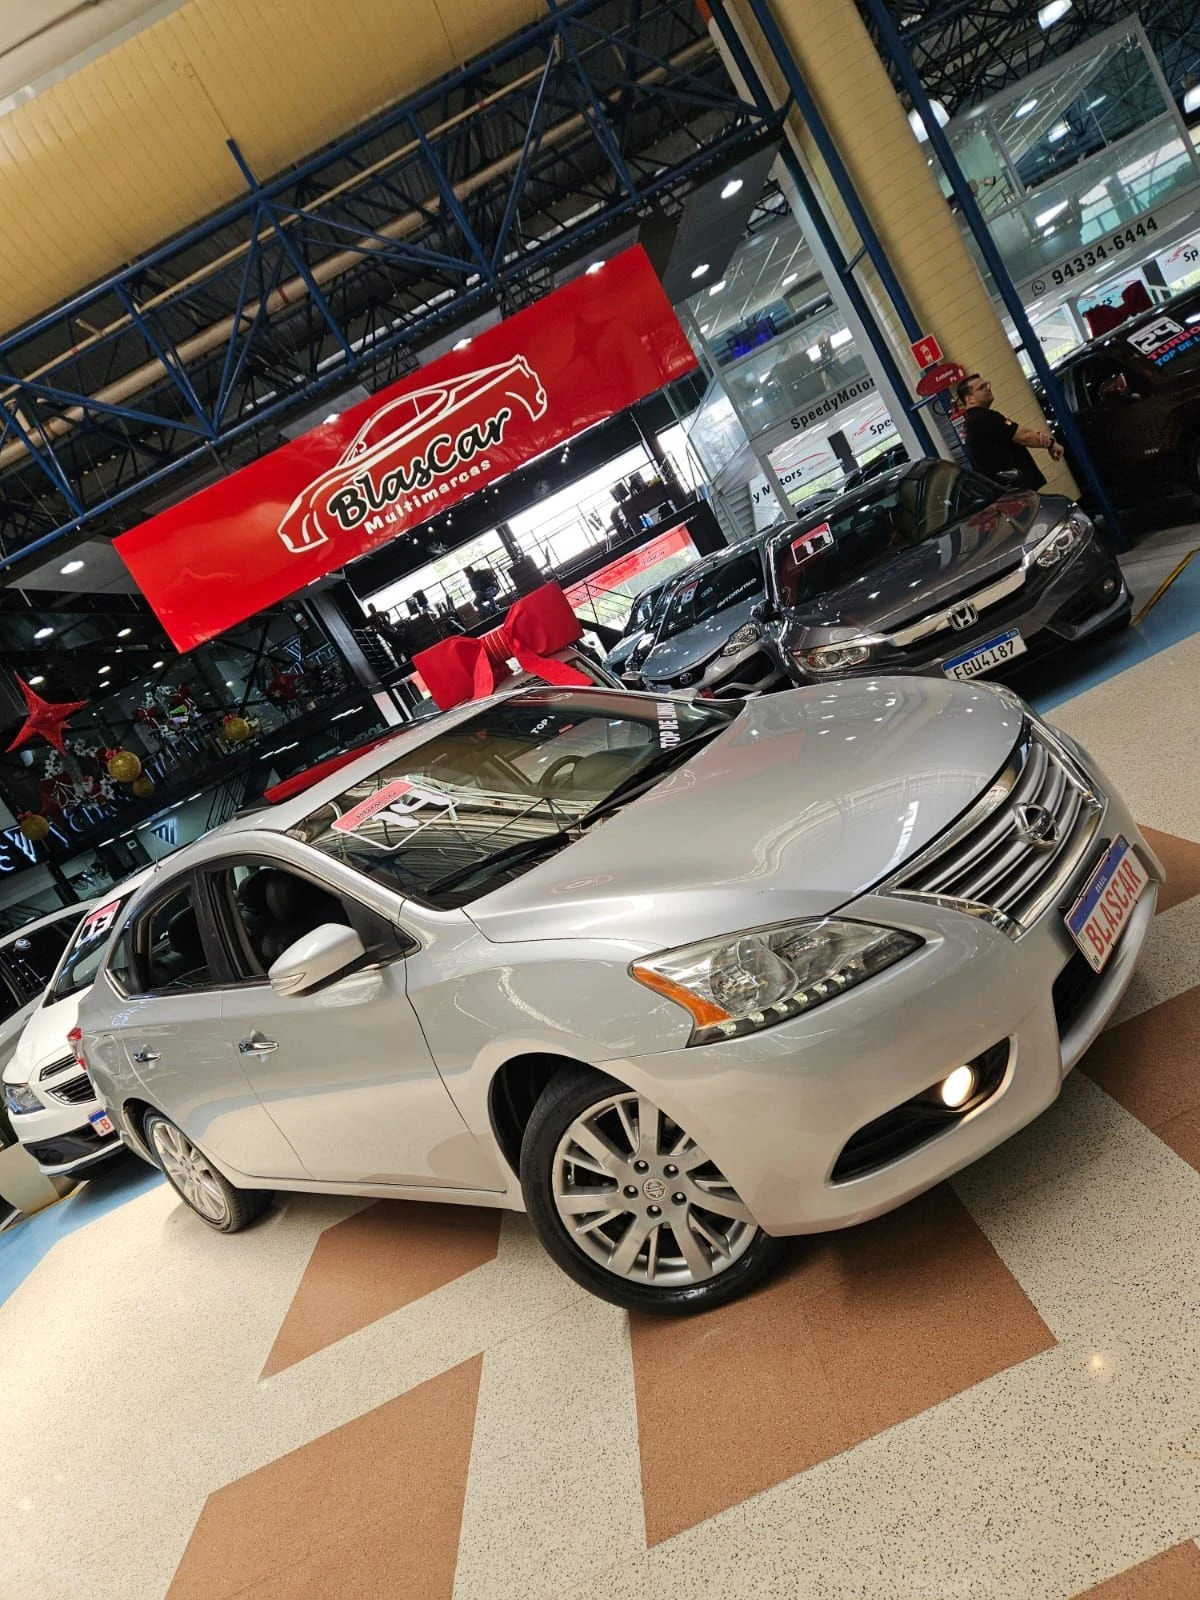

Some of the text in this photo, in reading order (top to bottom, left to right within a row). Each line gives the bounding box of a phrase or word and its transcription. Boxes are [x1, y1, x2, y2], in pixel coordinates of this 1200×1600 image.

[1051, 216, 1158, 285] 94334-6444
[1141, 322, 1181, 352] 24
[1146, 325, 1200, 361] TURBO
[1154, 349, 1176, 367] TOP
[1177, 339, 1194, 352] DE
[869, 418, 893, 436] Spe
[326, 408, 512, 530] BlasCar
[364, 459, 492, 535] Multimarcas
[658, 720, 679, 730] DE
[660, 730, 680, 749] TOP
[371, 787, 452, 828] 14
[1084, 858, 1142, 957] BLASCAR
